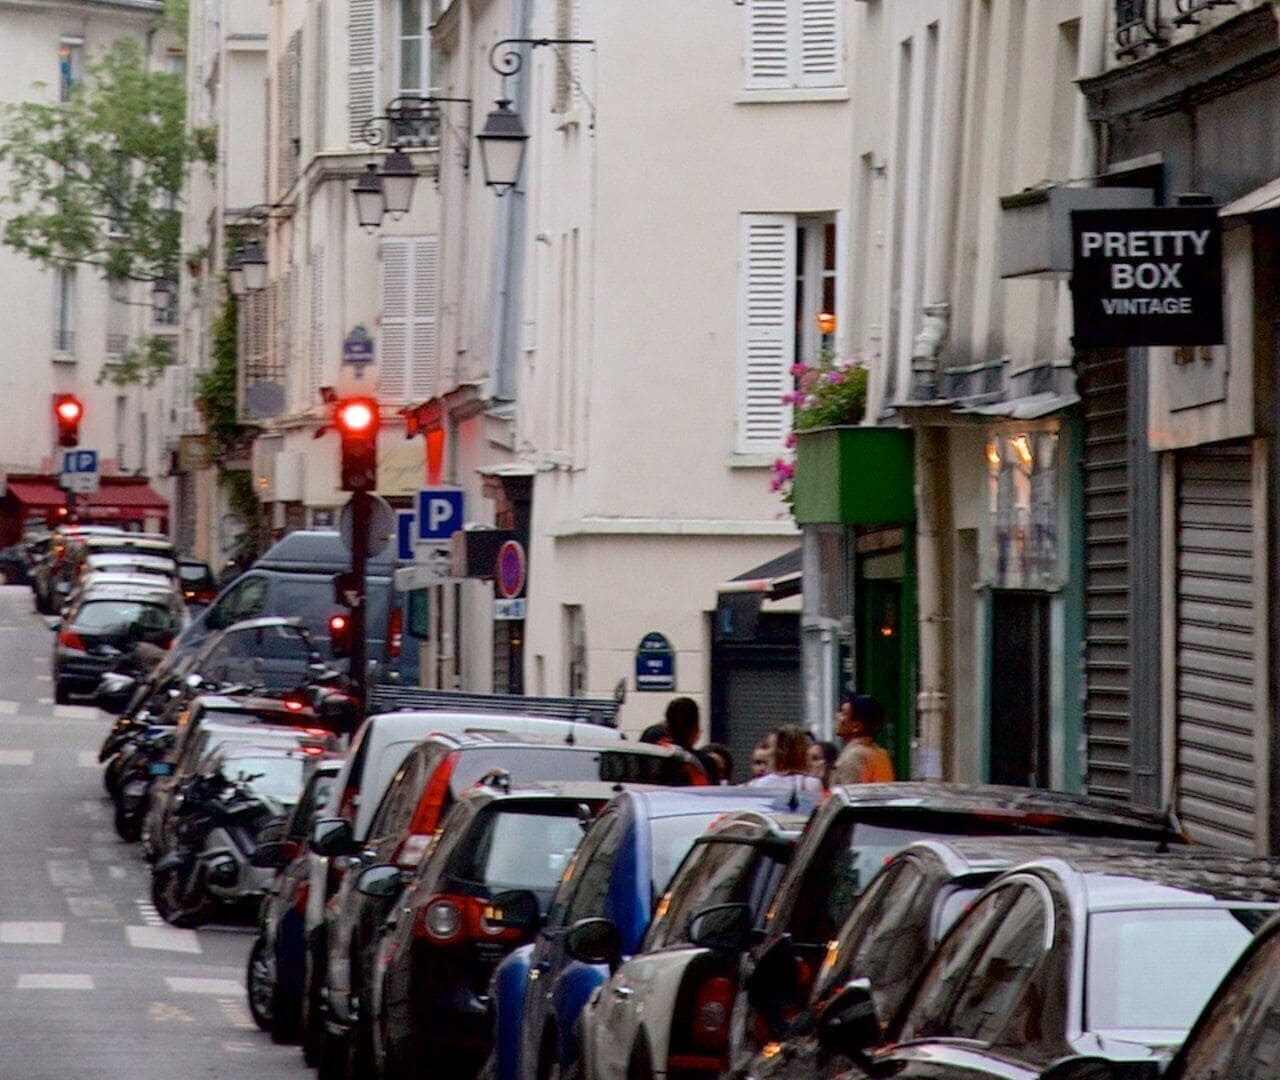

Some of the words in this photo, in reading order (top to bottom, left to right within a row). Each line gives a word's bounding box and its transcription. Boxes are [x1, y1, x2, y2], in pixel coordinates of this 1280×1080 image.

[1080, 230, 1211, 258] PRETTY
[1110, 262, 1183, 290] BOX
[1101, 297, 1193, 315] VINTAGE
[429, 498, 453, 531] P
